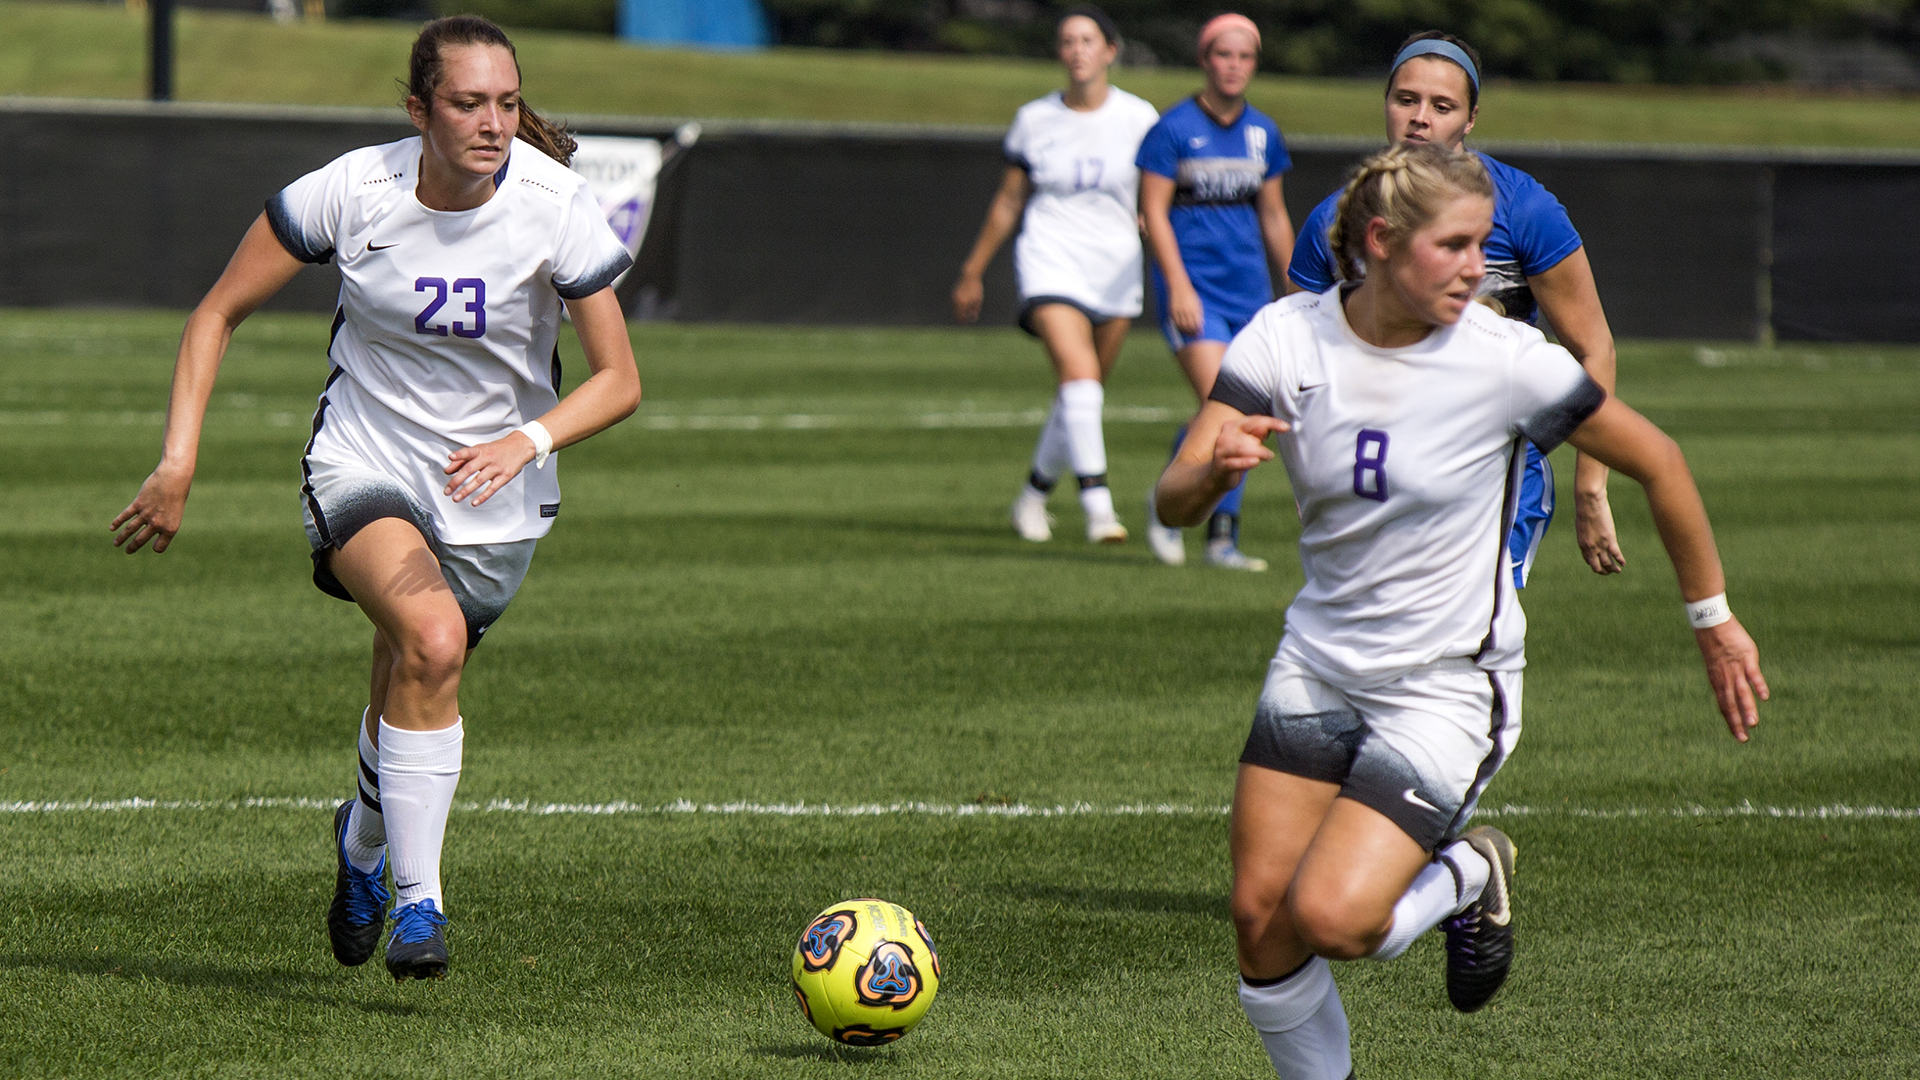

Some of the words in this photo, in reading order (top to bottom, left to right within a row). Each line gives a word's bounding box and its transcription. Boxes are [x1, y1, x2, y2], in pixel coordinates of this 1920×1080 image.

[414, 276, 486, 339] 23
[1353, 428, 1391, 503] 8
[865, 904, 887, 932] NCAA
